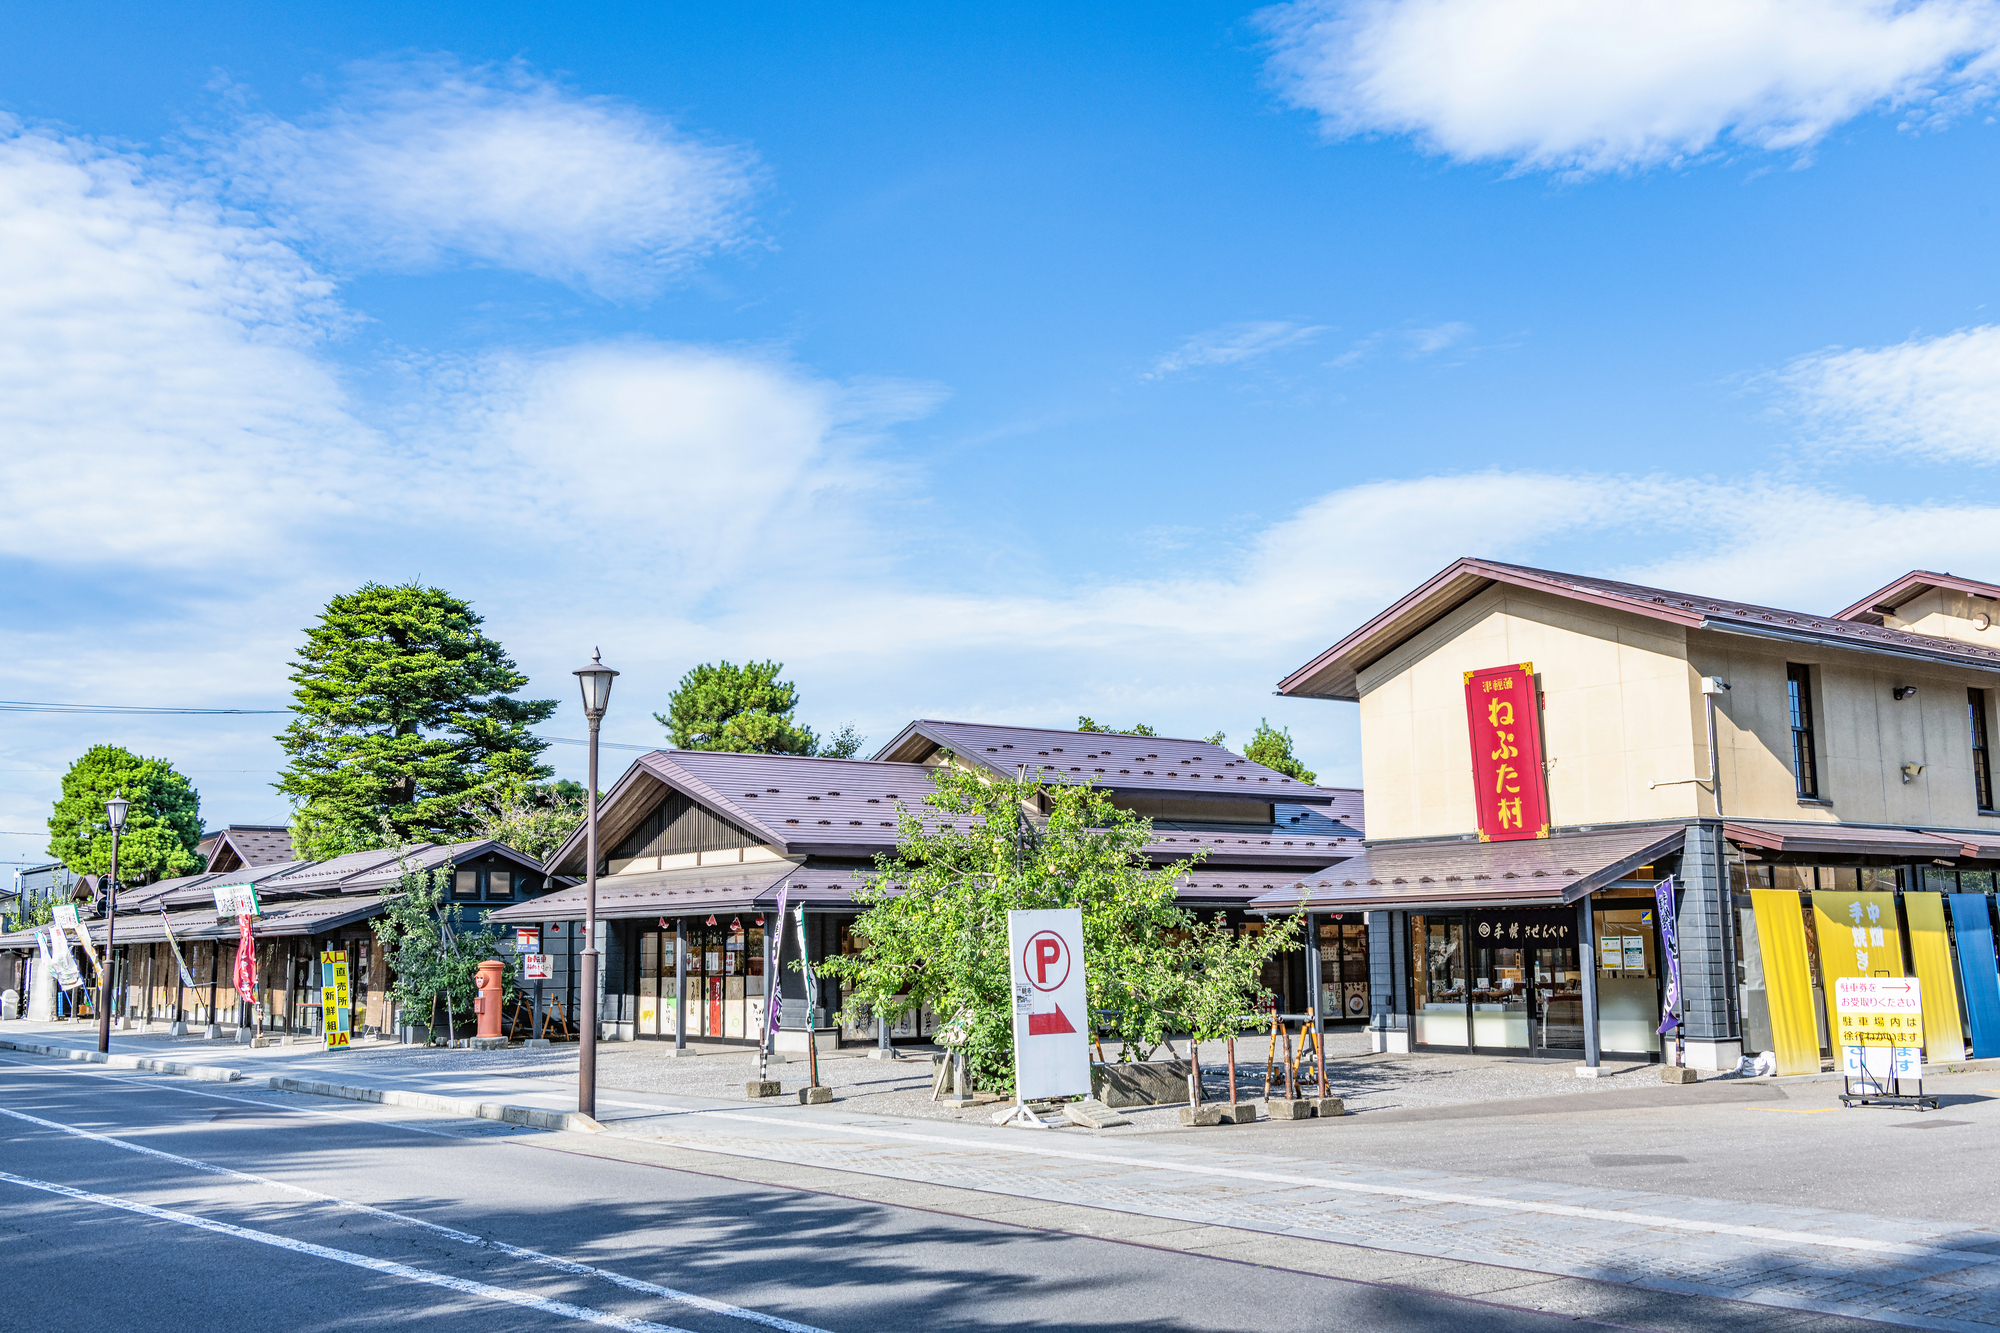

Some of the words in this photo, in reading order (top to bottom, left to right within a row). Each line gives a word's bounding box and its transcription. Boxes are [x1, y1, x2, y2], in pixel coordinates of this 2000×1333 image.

[1488, 697, 1523, 830] ねぷた村
[1848, 901, 1869, 977] 手焼き
[322, 950, 347, 963] 入口
[1035, 938, 1060, 984] P
[336, 967, 347, 1006] 直売所
[1840, 983, 1877, 992] 駐車券を
[1841, 997, 1916, 1007] お受取りください
[324, 991, 337, 1031] 新鮮組
[1842, 1016, 1917, 1027] 駐車場内は
[328, 1032, 349, 1046] JA
[1843, 1031, 1918, 1043] 徐行ねがいます
